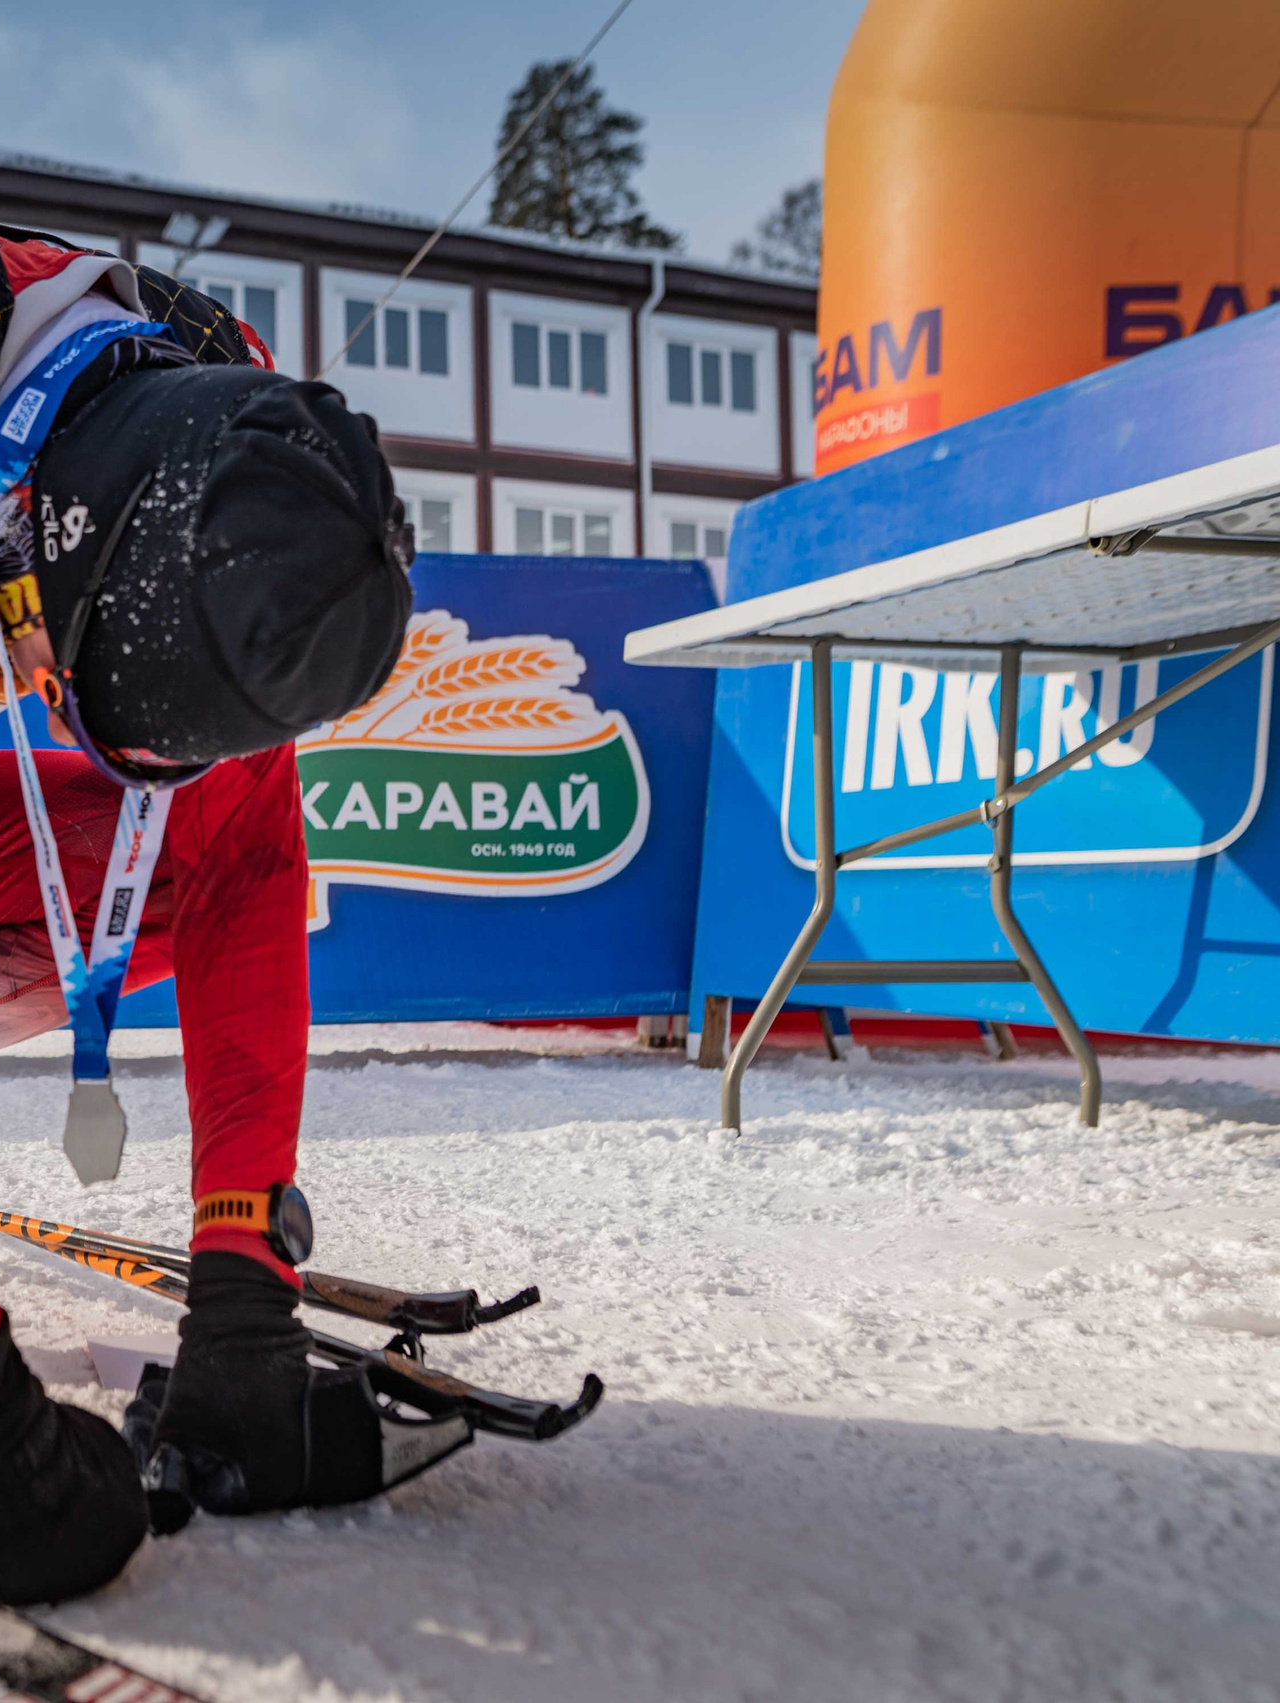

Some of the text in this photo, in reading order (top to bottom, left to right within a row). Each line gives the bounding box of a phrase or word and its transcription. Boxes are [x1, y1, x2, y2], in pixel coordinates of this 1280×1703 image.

[1104, 285, 1280, 359] БА
[300, 772, 601, 831] КАРАВАЙ
[471, 842, 576, 858] ОСН. 1949 ГОД
